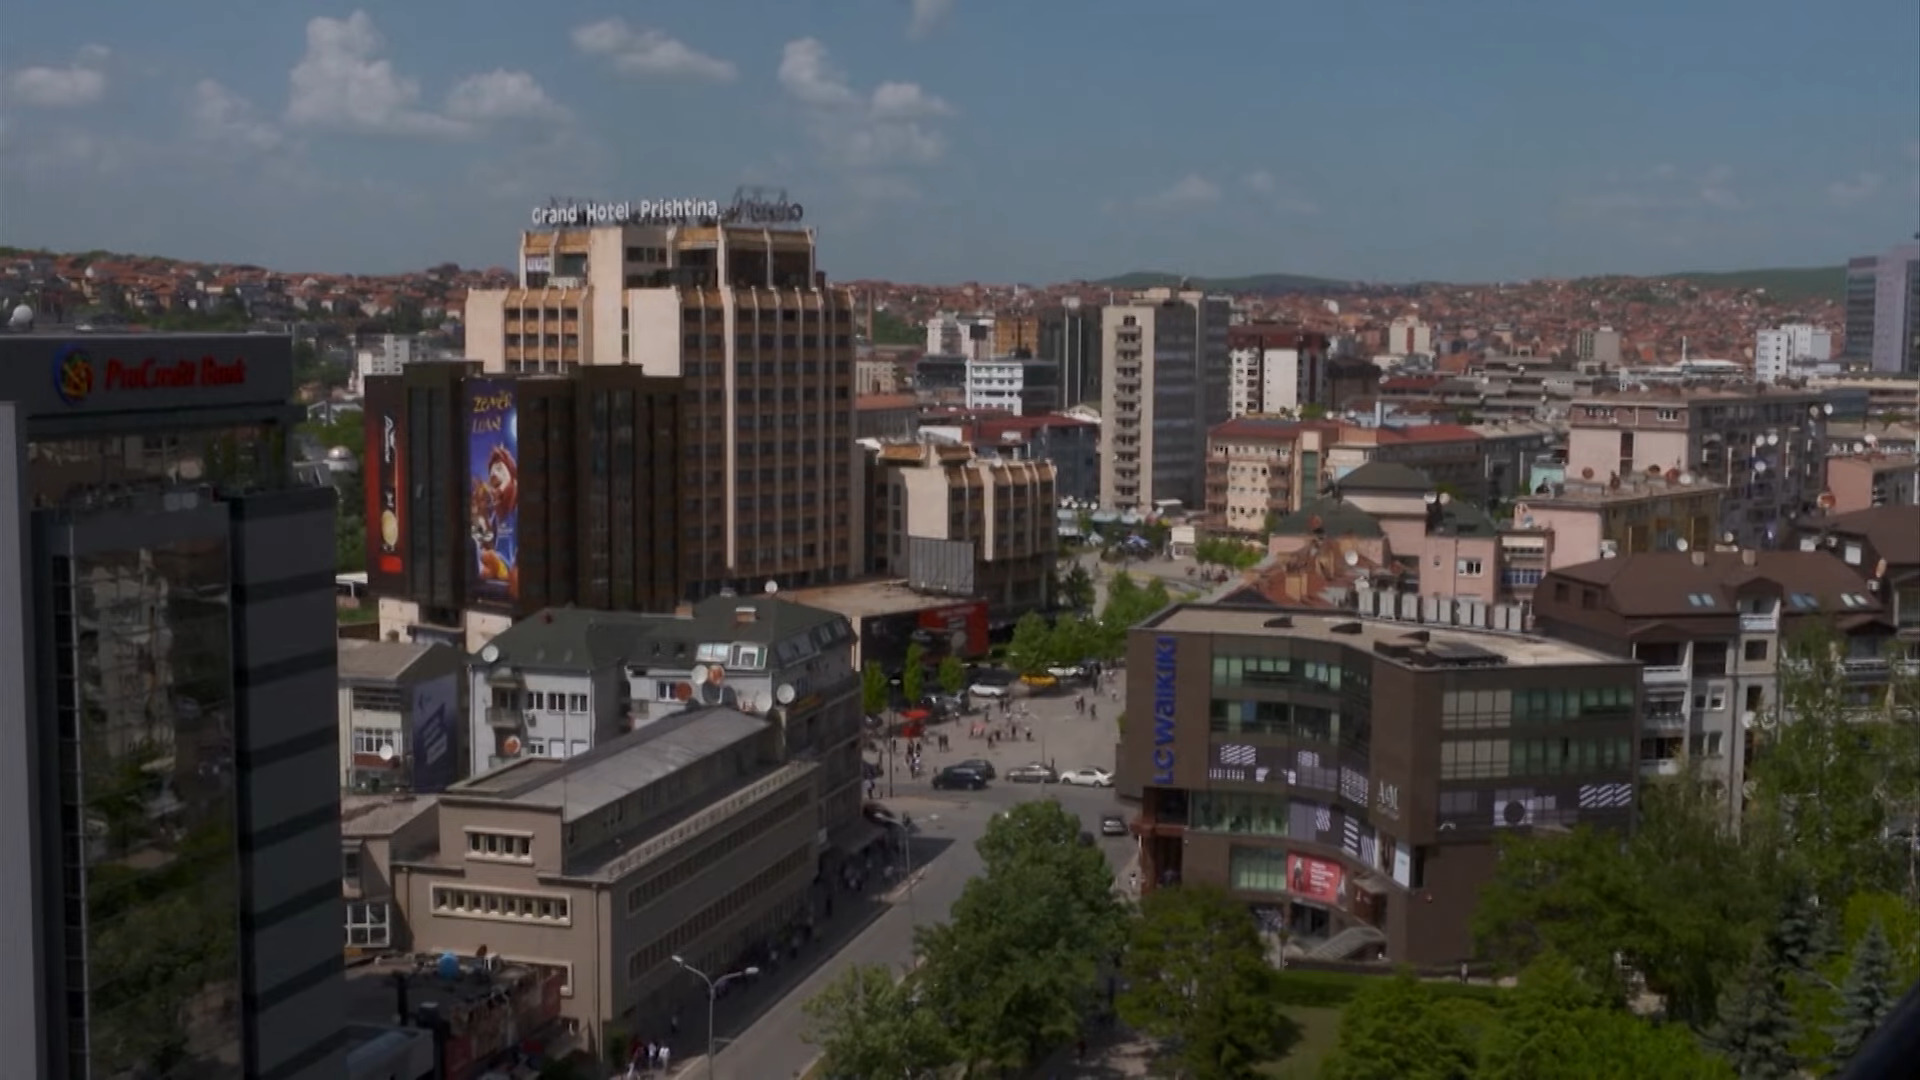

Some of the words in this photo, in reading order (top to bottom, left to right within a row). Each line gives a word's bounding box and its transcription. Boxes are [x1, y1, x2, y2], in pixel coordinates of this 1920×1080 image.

[532, 203, 578, 226] Grand
[587, 201, 630, 222] Hotel
[640, 197, 718, 218] Prishtina
[200, 354, 246, 386] Bank
